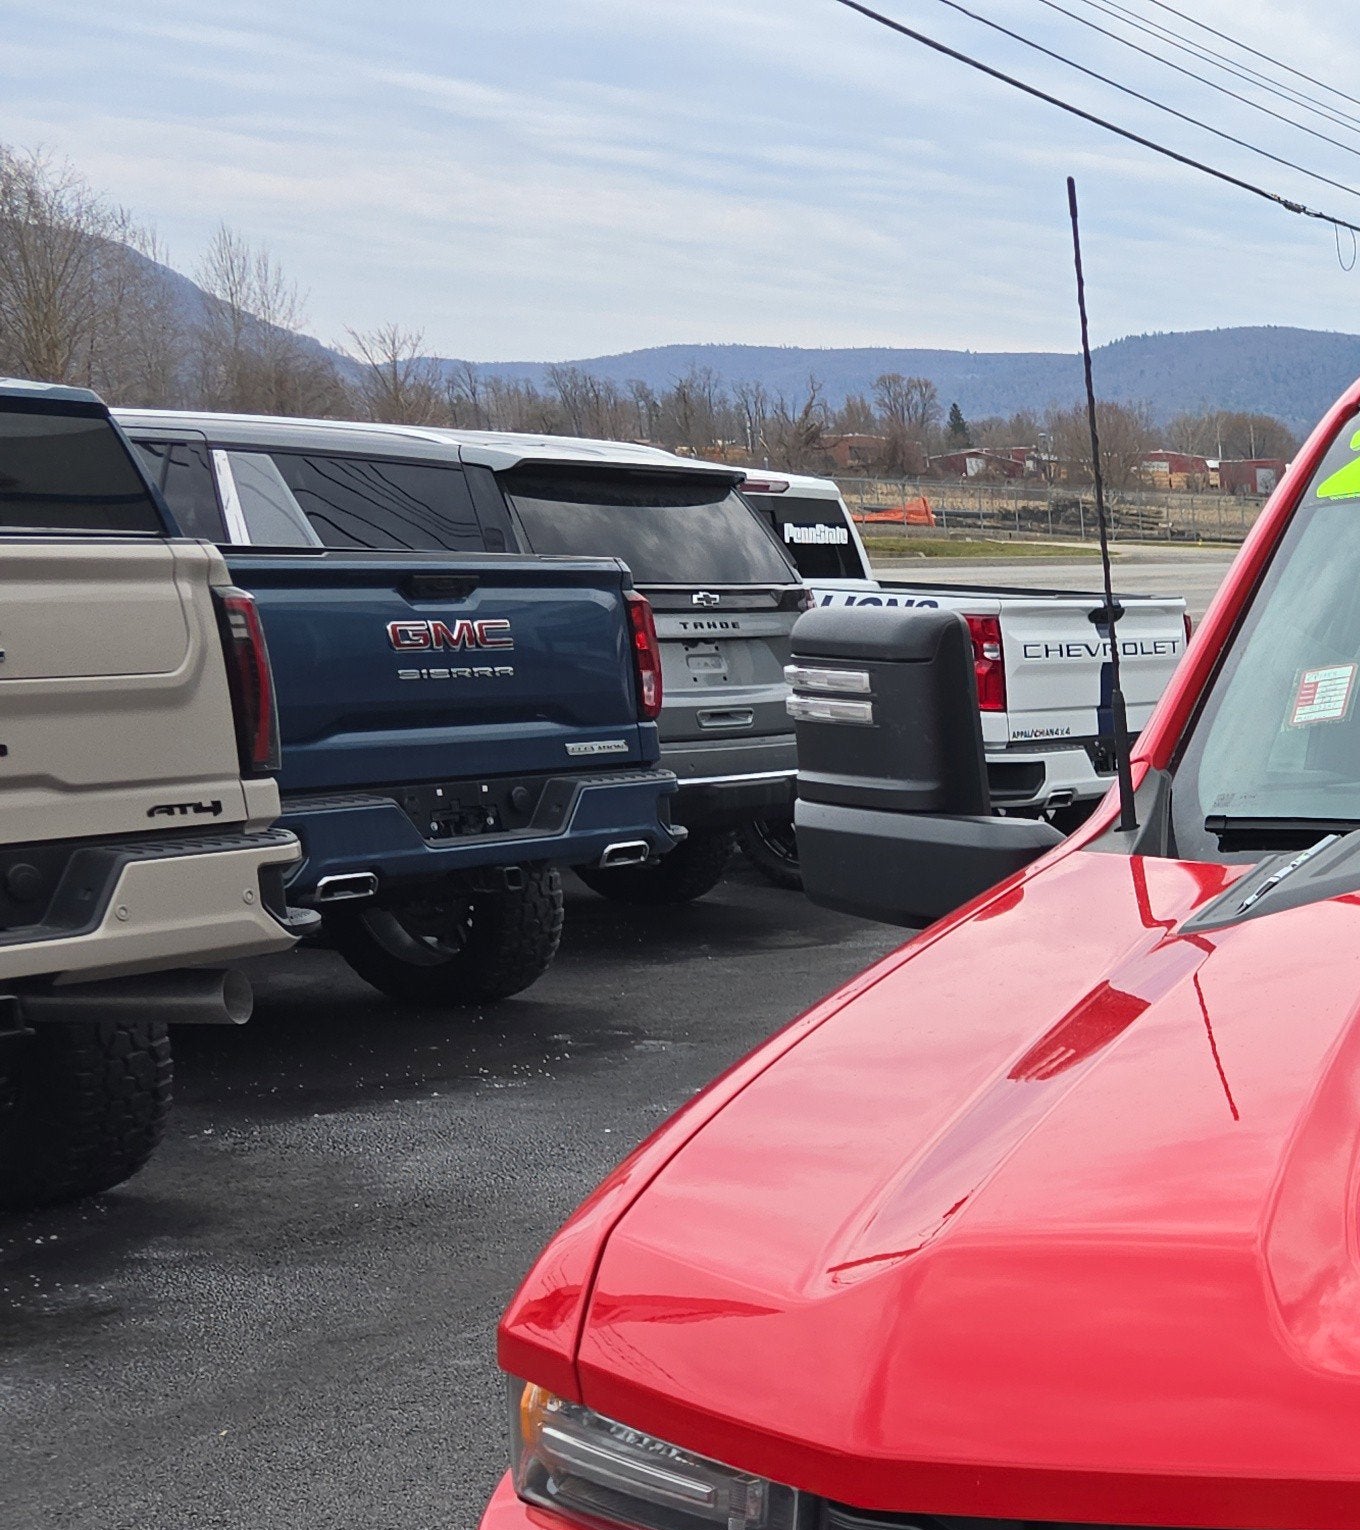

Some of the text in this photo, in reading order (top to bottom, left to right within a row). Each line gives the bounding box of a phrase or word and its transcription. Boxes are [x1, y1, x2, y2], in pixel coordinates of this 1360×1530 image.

[679, 621, 740, 630] TAHOE
[386, 619, 514, 651] GMC
[397, 666, 514, 680] SIERRA
[146, 800, 222, 818] AT4
